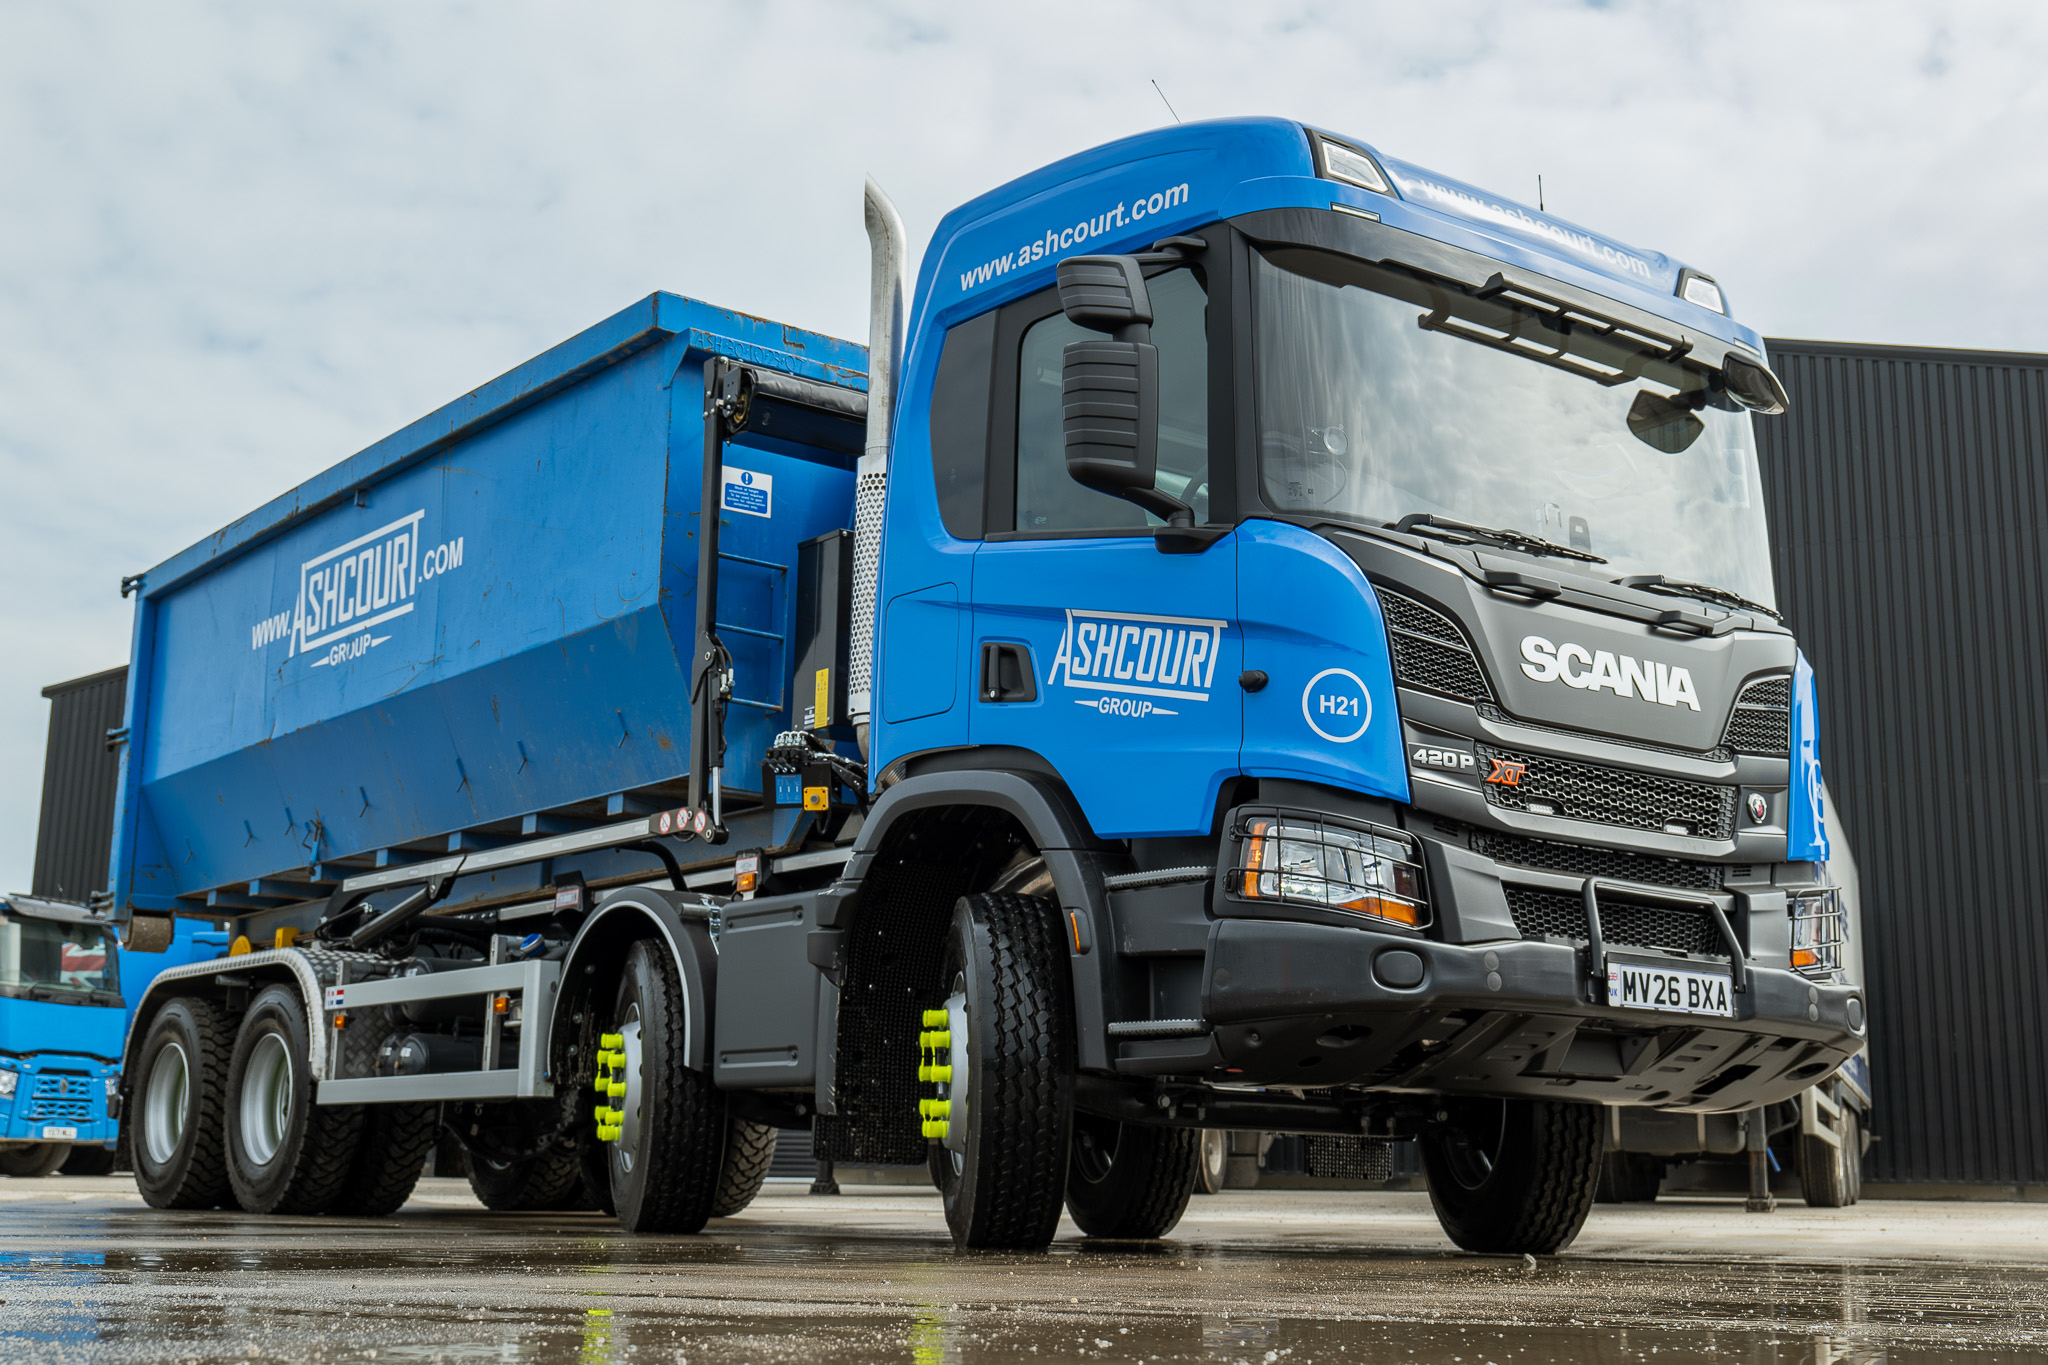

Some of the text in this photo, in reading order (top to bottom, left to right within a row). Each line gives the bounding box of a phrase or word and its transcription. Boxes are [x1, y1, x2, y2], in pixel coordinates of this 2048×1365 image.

[960, 182, 1189, 291] www.ashcourt.com
[329, 633, 372, 667] GROUP
[1047, 608, 1229, 702] ASHCOURT
[1519, 634, 1701, 713] SCANIA
[1098, 696, 1153, 718] GROUP
[1319, 694, 1359, 717] H21
[1412, 748, 1459, 769] 420
[1486, 759, 1526, 786] XT
[1622, 970, 1728, 1011] MV26 BXA
